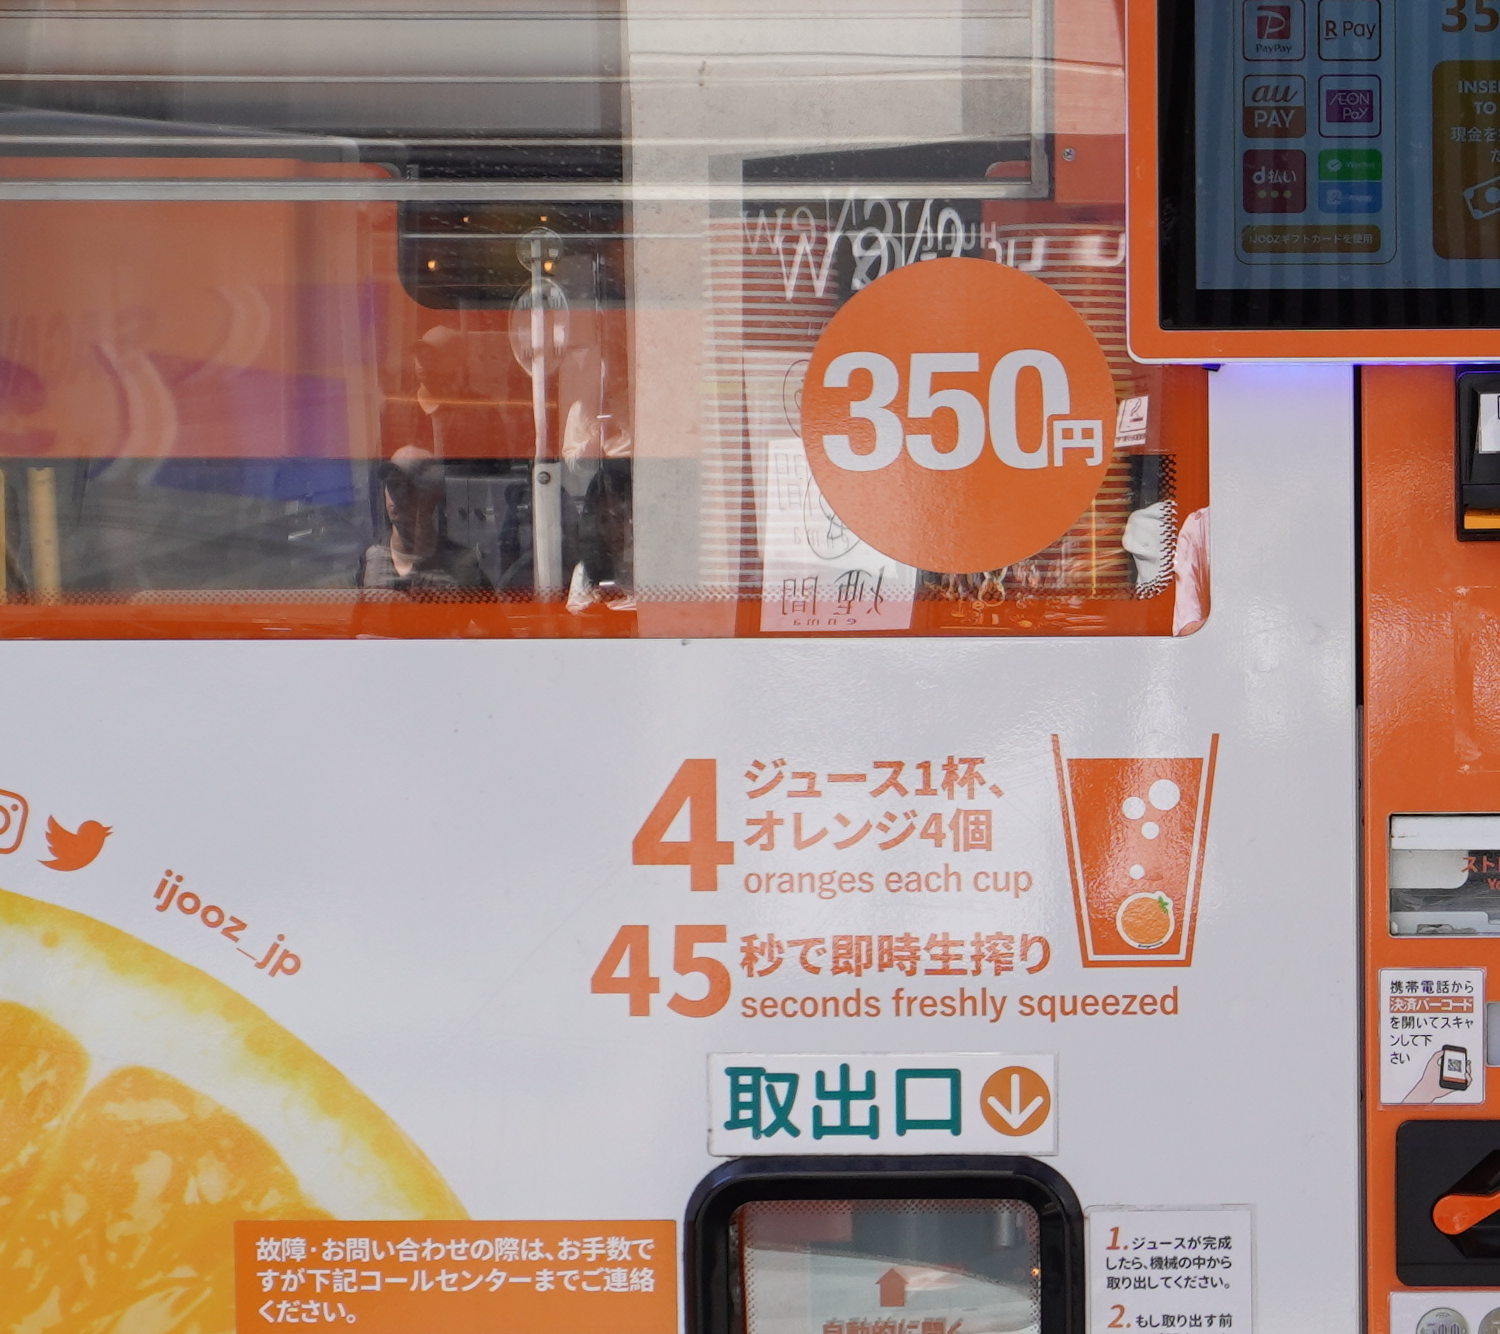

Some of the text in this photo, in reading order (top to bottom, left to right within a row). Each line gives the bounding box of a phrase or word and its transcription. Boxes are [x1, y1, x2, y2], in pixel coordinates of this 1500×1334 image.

[1474, 101, 1496, 114] TO
[823, 350, 1103, 472] 350円
[745, 756, 1004, 799] ジュース1杯、
[632, 759, 734, 891] 4
[745, 809, 991, 852] オレンジ4個
[745, 865, 1032, 900] oranges each cup
[154, 870, 300, 977] ijooz_jp
[591, 925, 731, 1017] 45
[740, 933, 1050, 976] 秒で即時生搾り
[741, 987, 1178, 1022] seconds freshly squeezed
[1390, 980, 1474, 994] 携帯電話から
[1390, 997, 1473, 1011] 決済バーコード
[725, 1064, 961, 1139] 取出口
[256, 1268, 655, 1294] すが下記コールセンターまでご連絡
[1106, 1275, 1231, 1290] 取り出してください。
[257, 1299, 357, 1324] ください。
